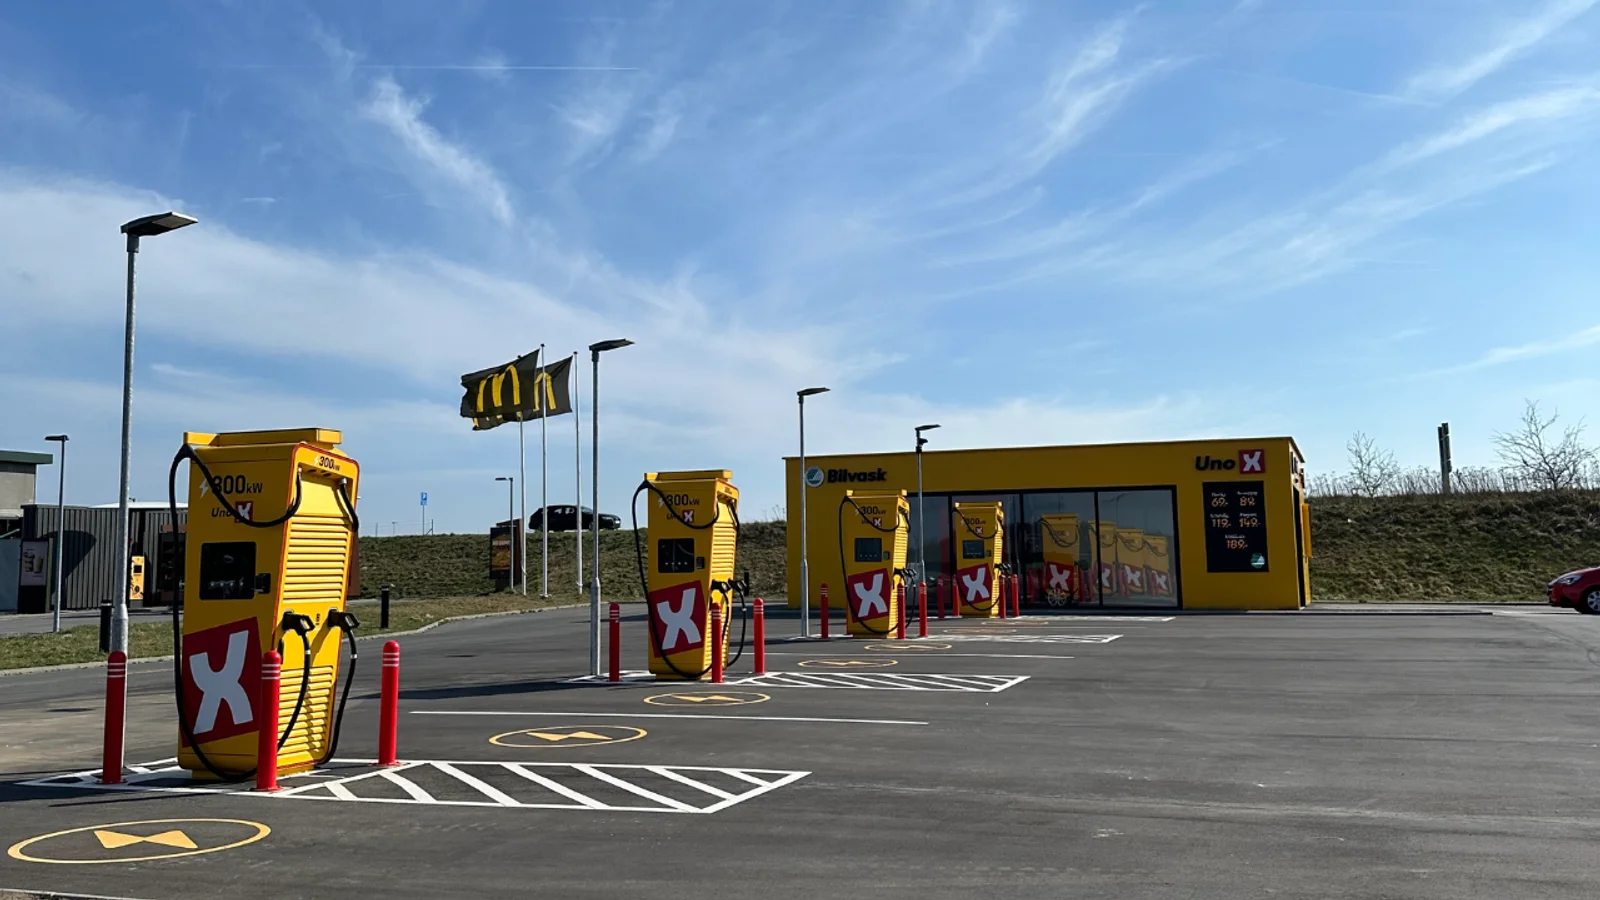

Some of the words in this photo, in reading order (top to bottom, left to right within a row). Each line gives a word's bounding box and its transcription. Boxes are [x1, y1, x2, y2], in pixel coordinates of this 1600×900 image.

[828, 468, 887, 483] Bilvask
[1195, 456, 1236, 471] Uno
[1243, 451, 1261, 471] X
[853, 573, 888, 618] X
[962, 567, 990, 602] X
[656, 587, 702, 650] X
[189, 629, 254, 735] X
